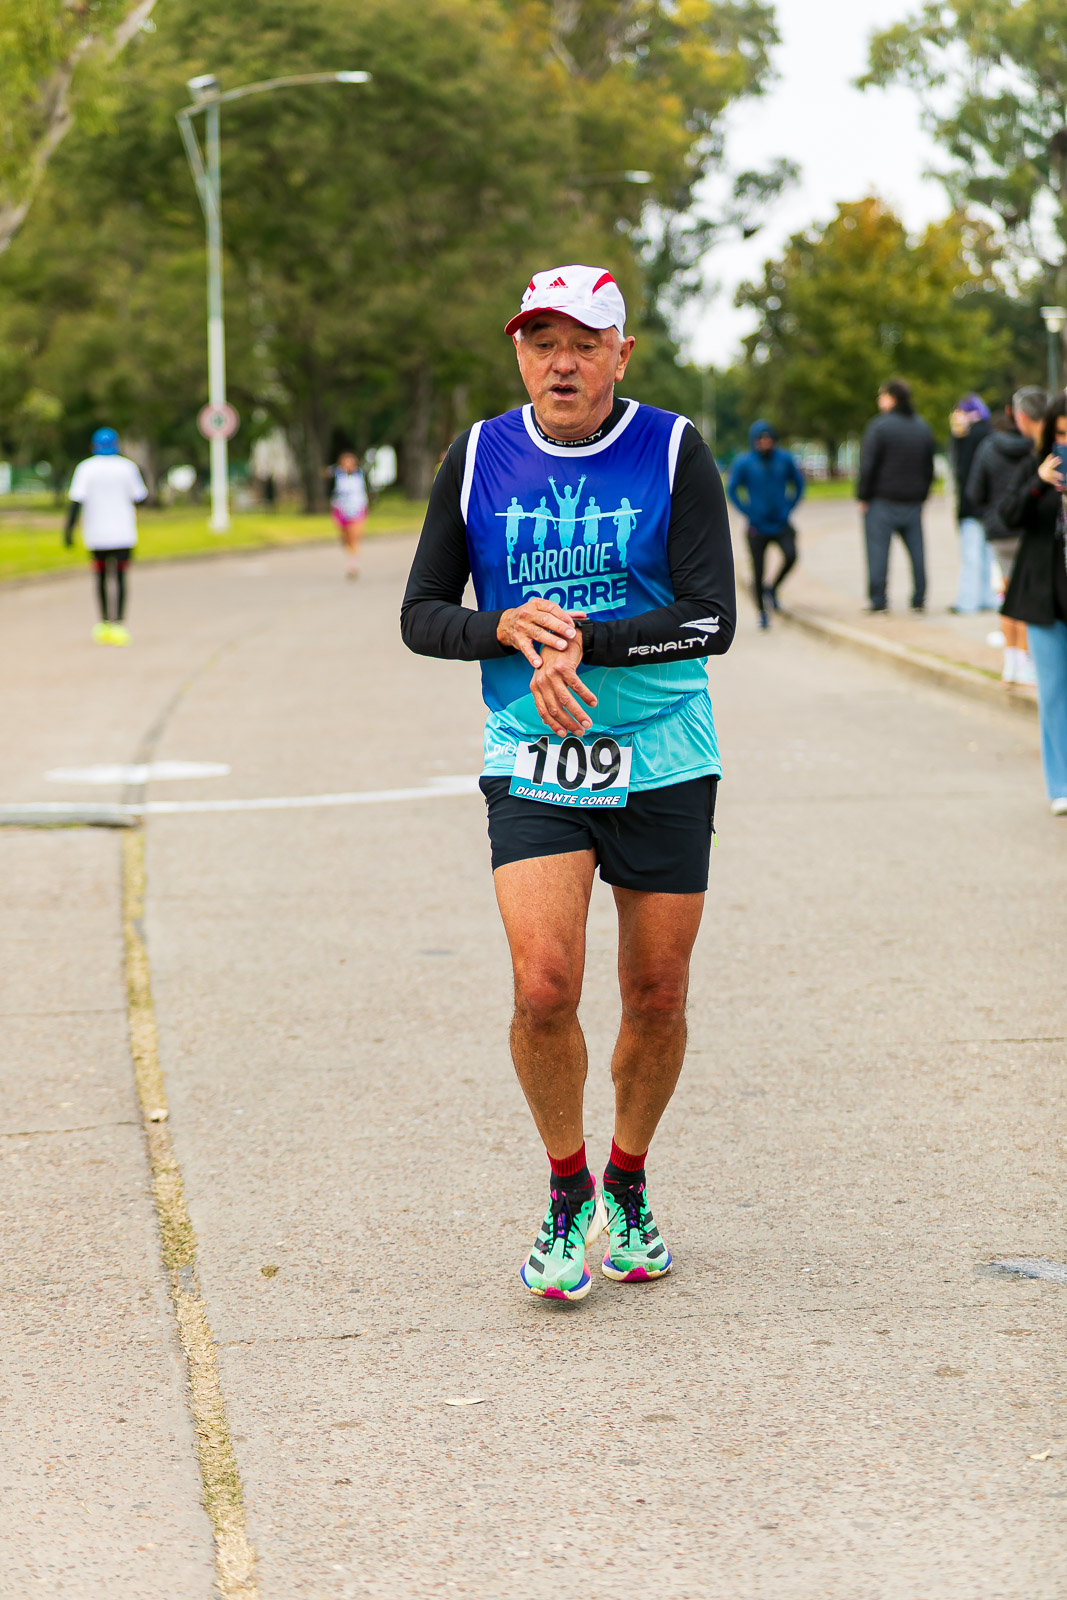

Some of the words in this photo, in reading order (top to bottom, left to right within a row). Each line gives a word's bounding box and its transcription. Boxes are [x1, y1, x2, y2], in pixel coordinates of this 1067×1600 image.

[548, 430, 602, 446] PENALTY
[507, 543, 613, 584] LARROQUE
[628, 635, 708, 656] PENALTY
[528, 736, 621, 792] 109
[515, 786, 579, 804] DIAMANTE
[579, 796, 621, 805] CORRE
